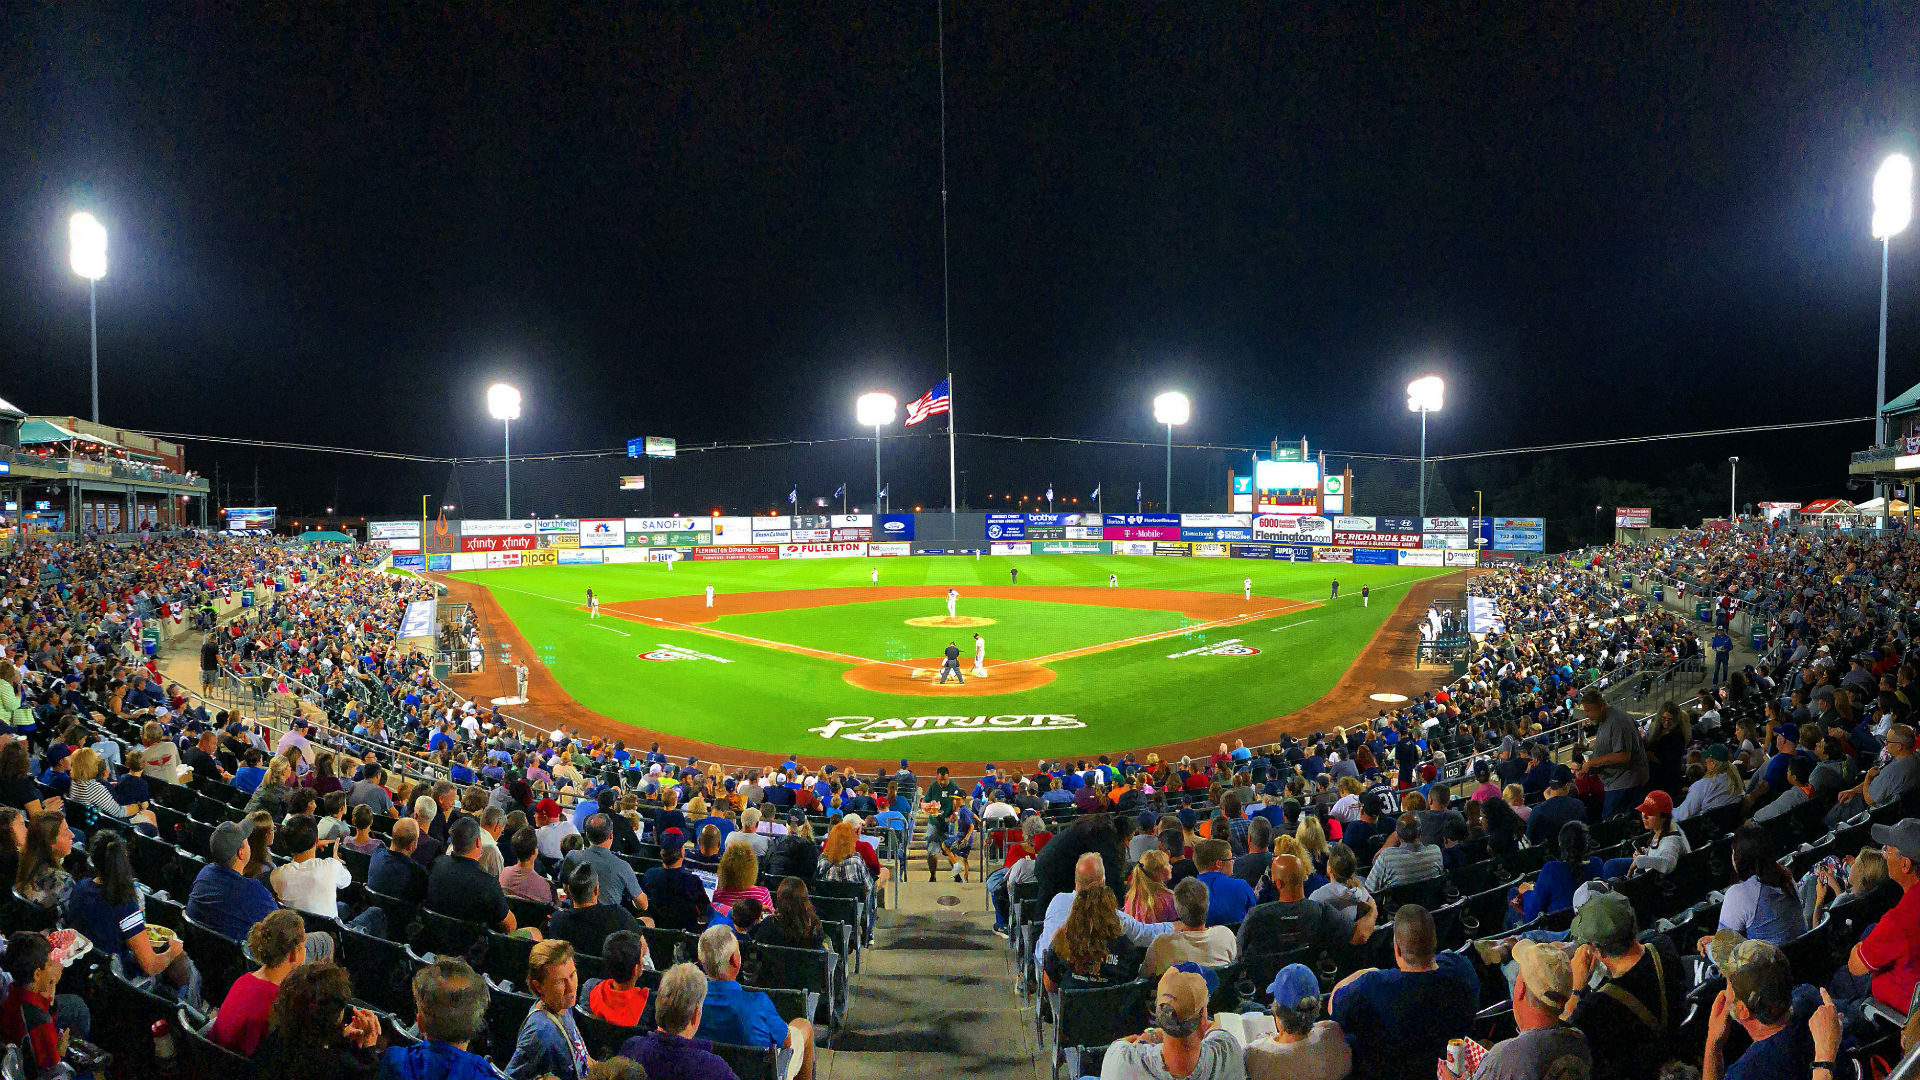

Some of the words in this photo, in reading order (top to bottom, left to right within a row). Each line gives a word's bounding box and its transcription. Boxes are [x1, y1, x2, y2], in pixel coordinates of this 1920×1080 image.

[1028, 513, 1058, 522] brother
[538, 520, 578, 529] Northfield
[642, 520, 681, 529] SANOFI
[1259, 518, 1279, 528] 6000
[1430, 518, 1459, 528] Tirpok
[1255, 530, 1331, 544] Flemington.com
[1400, 535, 1420, 543] SON
[467, 537, 497, 550] xfinity
[502, 536, 530, 549] xfinity
[801, 544, 859, 552] FULLERTON
[1275, 547, 1308, 555] SUPERCUTS
[808, 715, 1088, 738] PATRIOTS
[434, 770, 448, 780] 104
[1445, 767, 1459, 778] 103
[1378, 791, 1398, 814] 31
